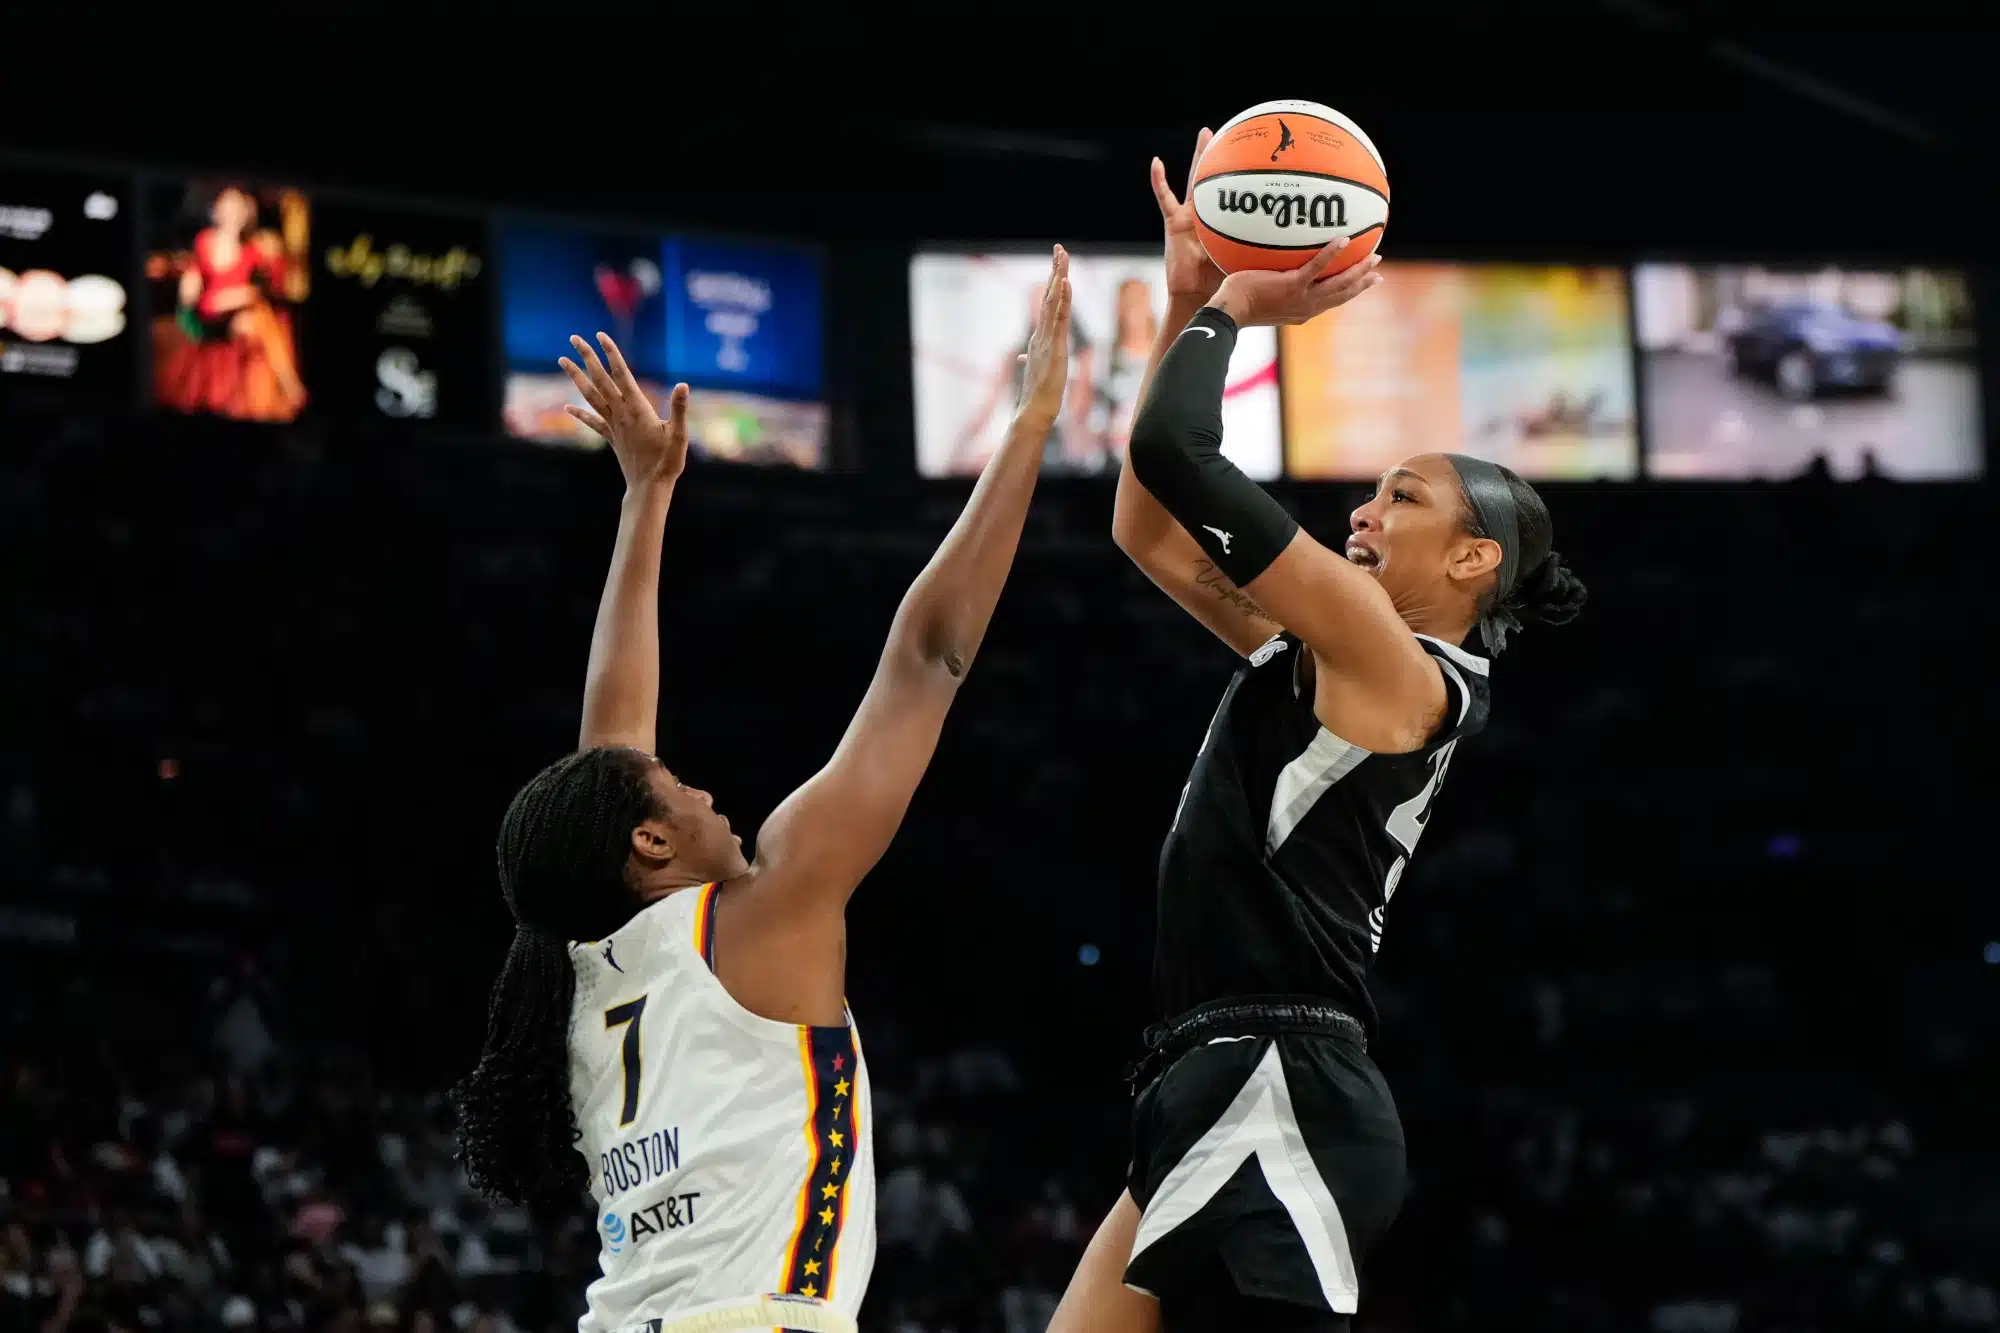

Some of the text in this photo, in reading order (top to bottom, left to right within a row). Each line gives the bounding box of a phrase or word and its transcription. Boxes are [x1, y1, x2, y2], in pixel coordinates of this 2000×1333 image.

[1217, 188, 1348, 229] Wilson
[604, 994, 648, 1130] 7
[602, 1127, 678, 1196] BOSTON
[631, 1192, 700, 1243] AT&T
